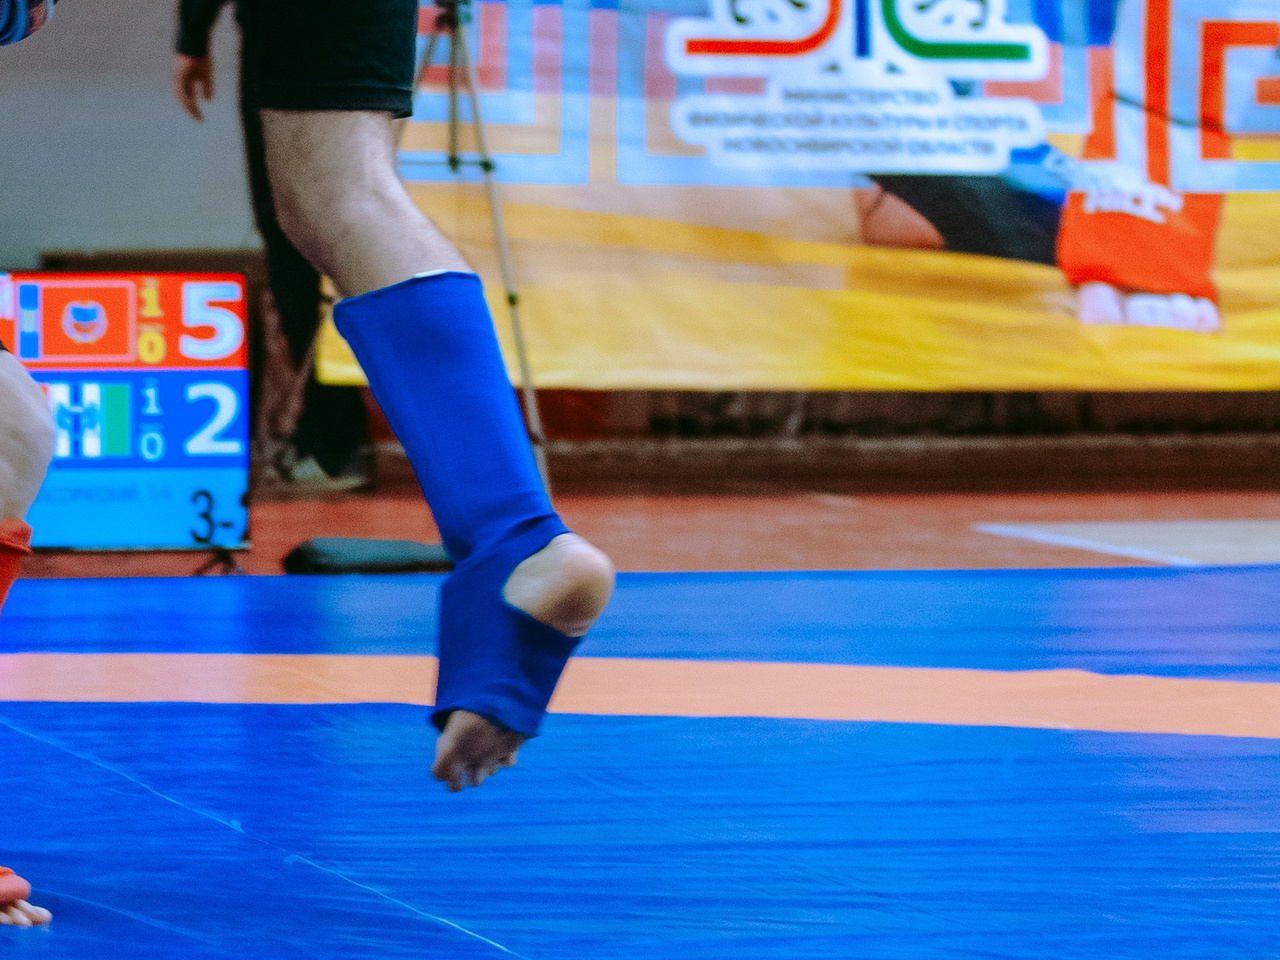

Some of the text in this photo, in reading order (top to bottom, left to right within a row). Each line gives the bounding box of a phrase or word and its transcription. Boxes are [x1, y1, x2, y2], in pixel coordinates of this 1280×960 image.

[180, 282, 244, 360] 5
[137, 331, 166, 364] 0
[184, 383, 242, 455] 2
[140, 431, 165, 462] 0
